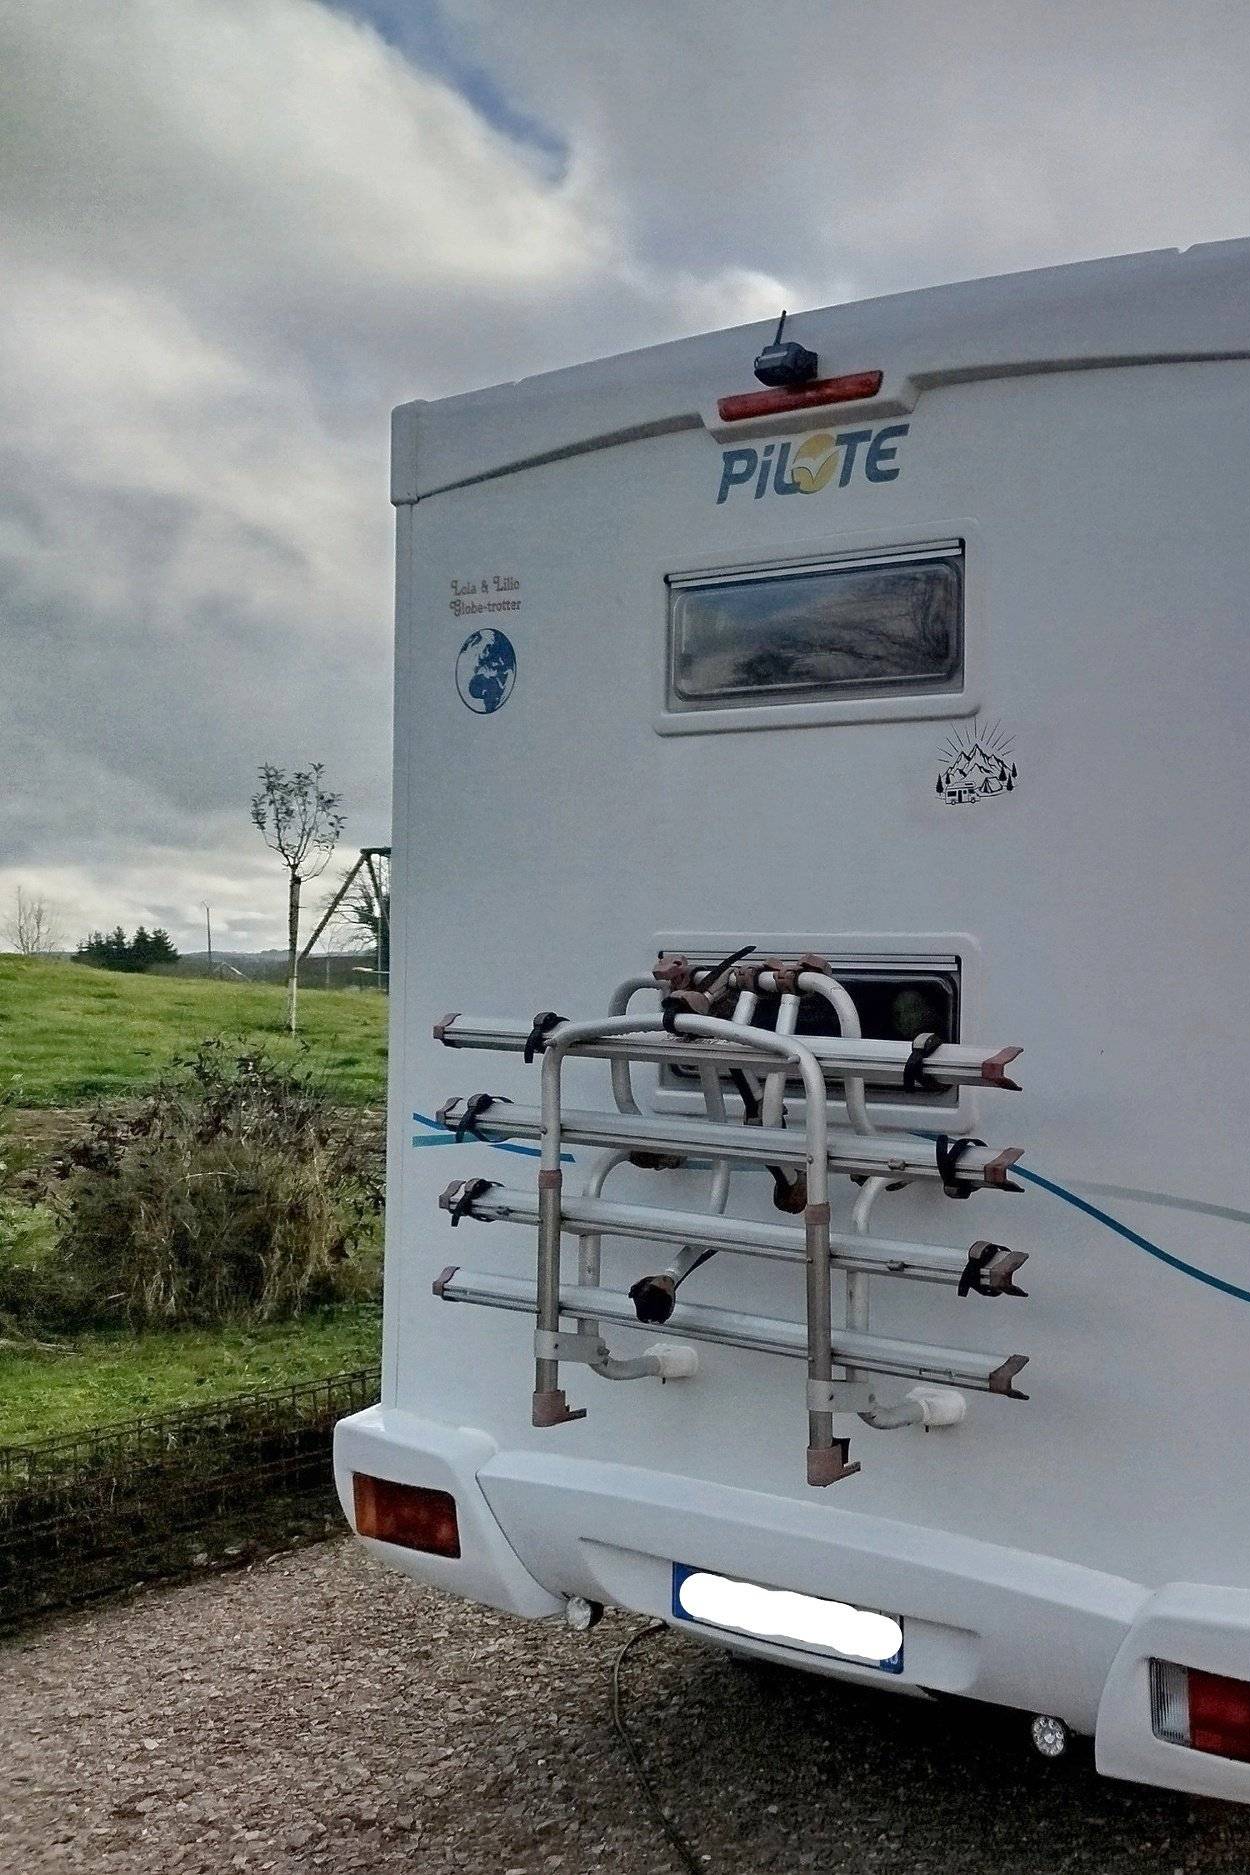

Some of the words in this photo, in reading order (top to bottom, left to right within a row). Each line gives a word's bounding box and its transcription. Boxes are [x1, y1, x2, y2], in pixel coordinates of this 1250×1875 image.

[451, 580, 477, 596] Lola
[481, 580, 489, 594] &
[450, 599, 521, 617] Globe-trotter
